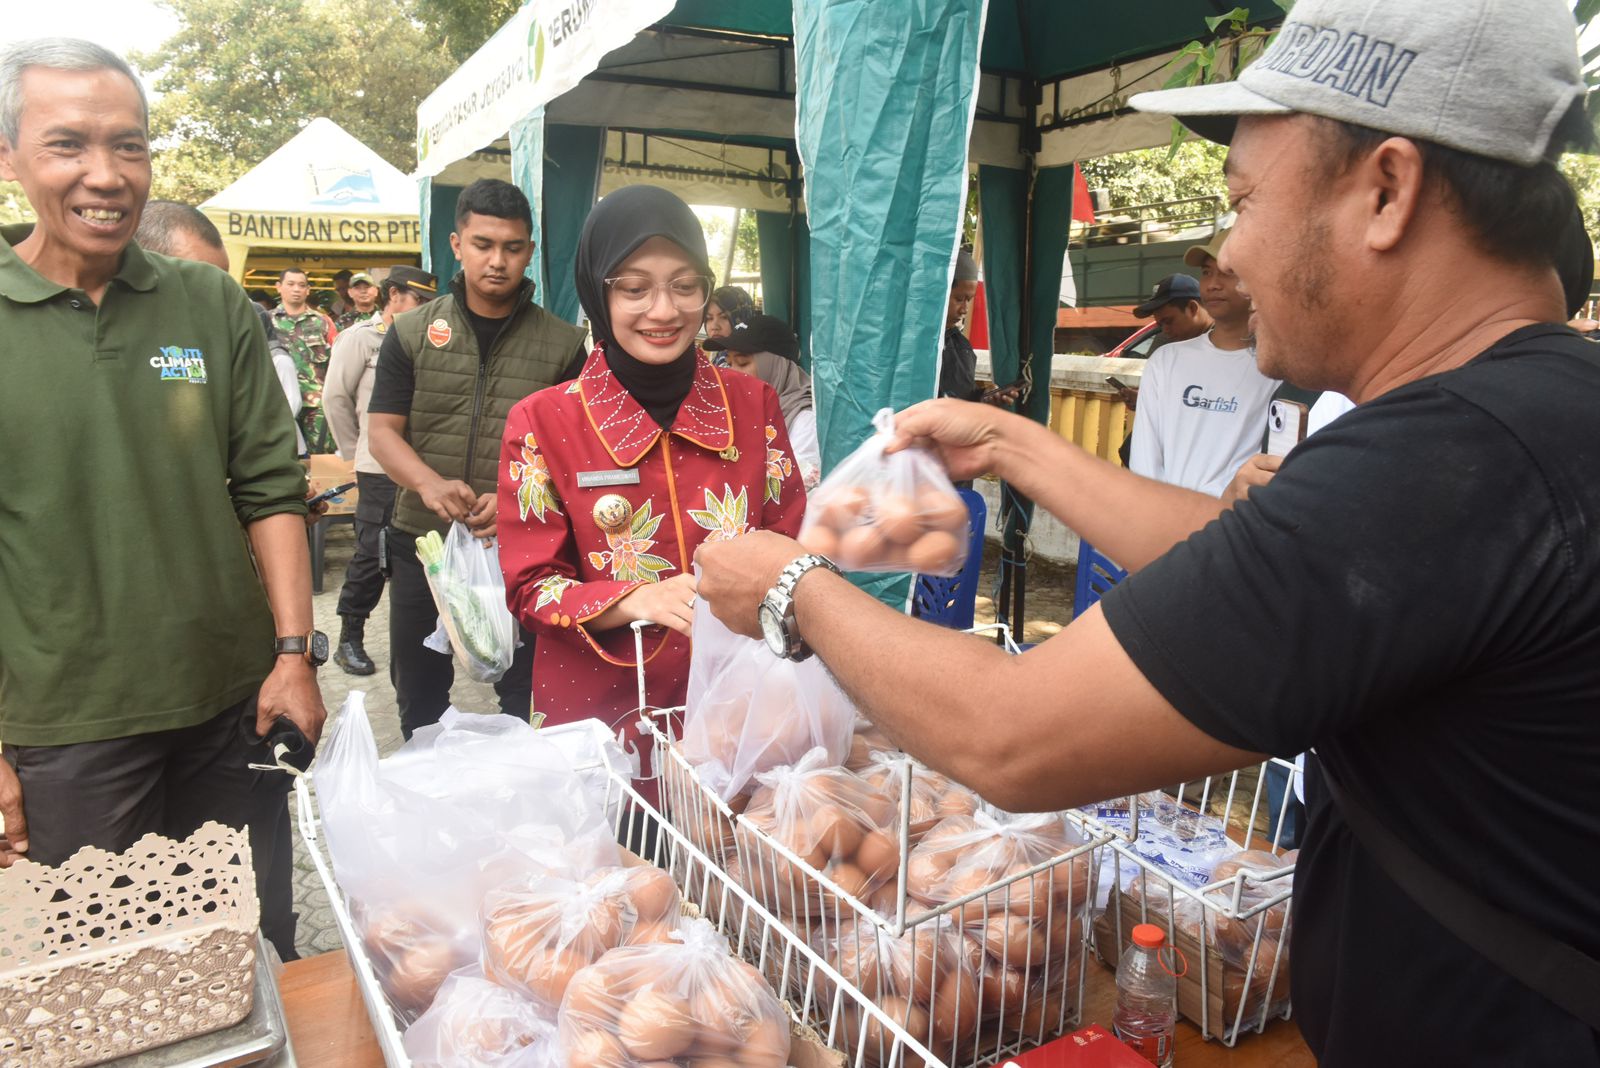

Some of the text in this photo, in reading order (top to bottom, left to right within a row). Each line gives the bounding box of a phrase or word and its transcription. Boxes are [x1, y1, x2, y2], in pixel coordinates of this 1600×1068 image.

[548, 0, 597, 48] PERUM
[1256, 22, 1418, 108] ORDAN
[229, 212, 331, 242] BANTUAN
[339, 220, 381, 242] CSR
[150, 356, 206, 368] CLIMATE
[1183, 385, 1238, 413] Garfish
[1105, 810, 1147, 819] BAMU
